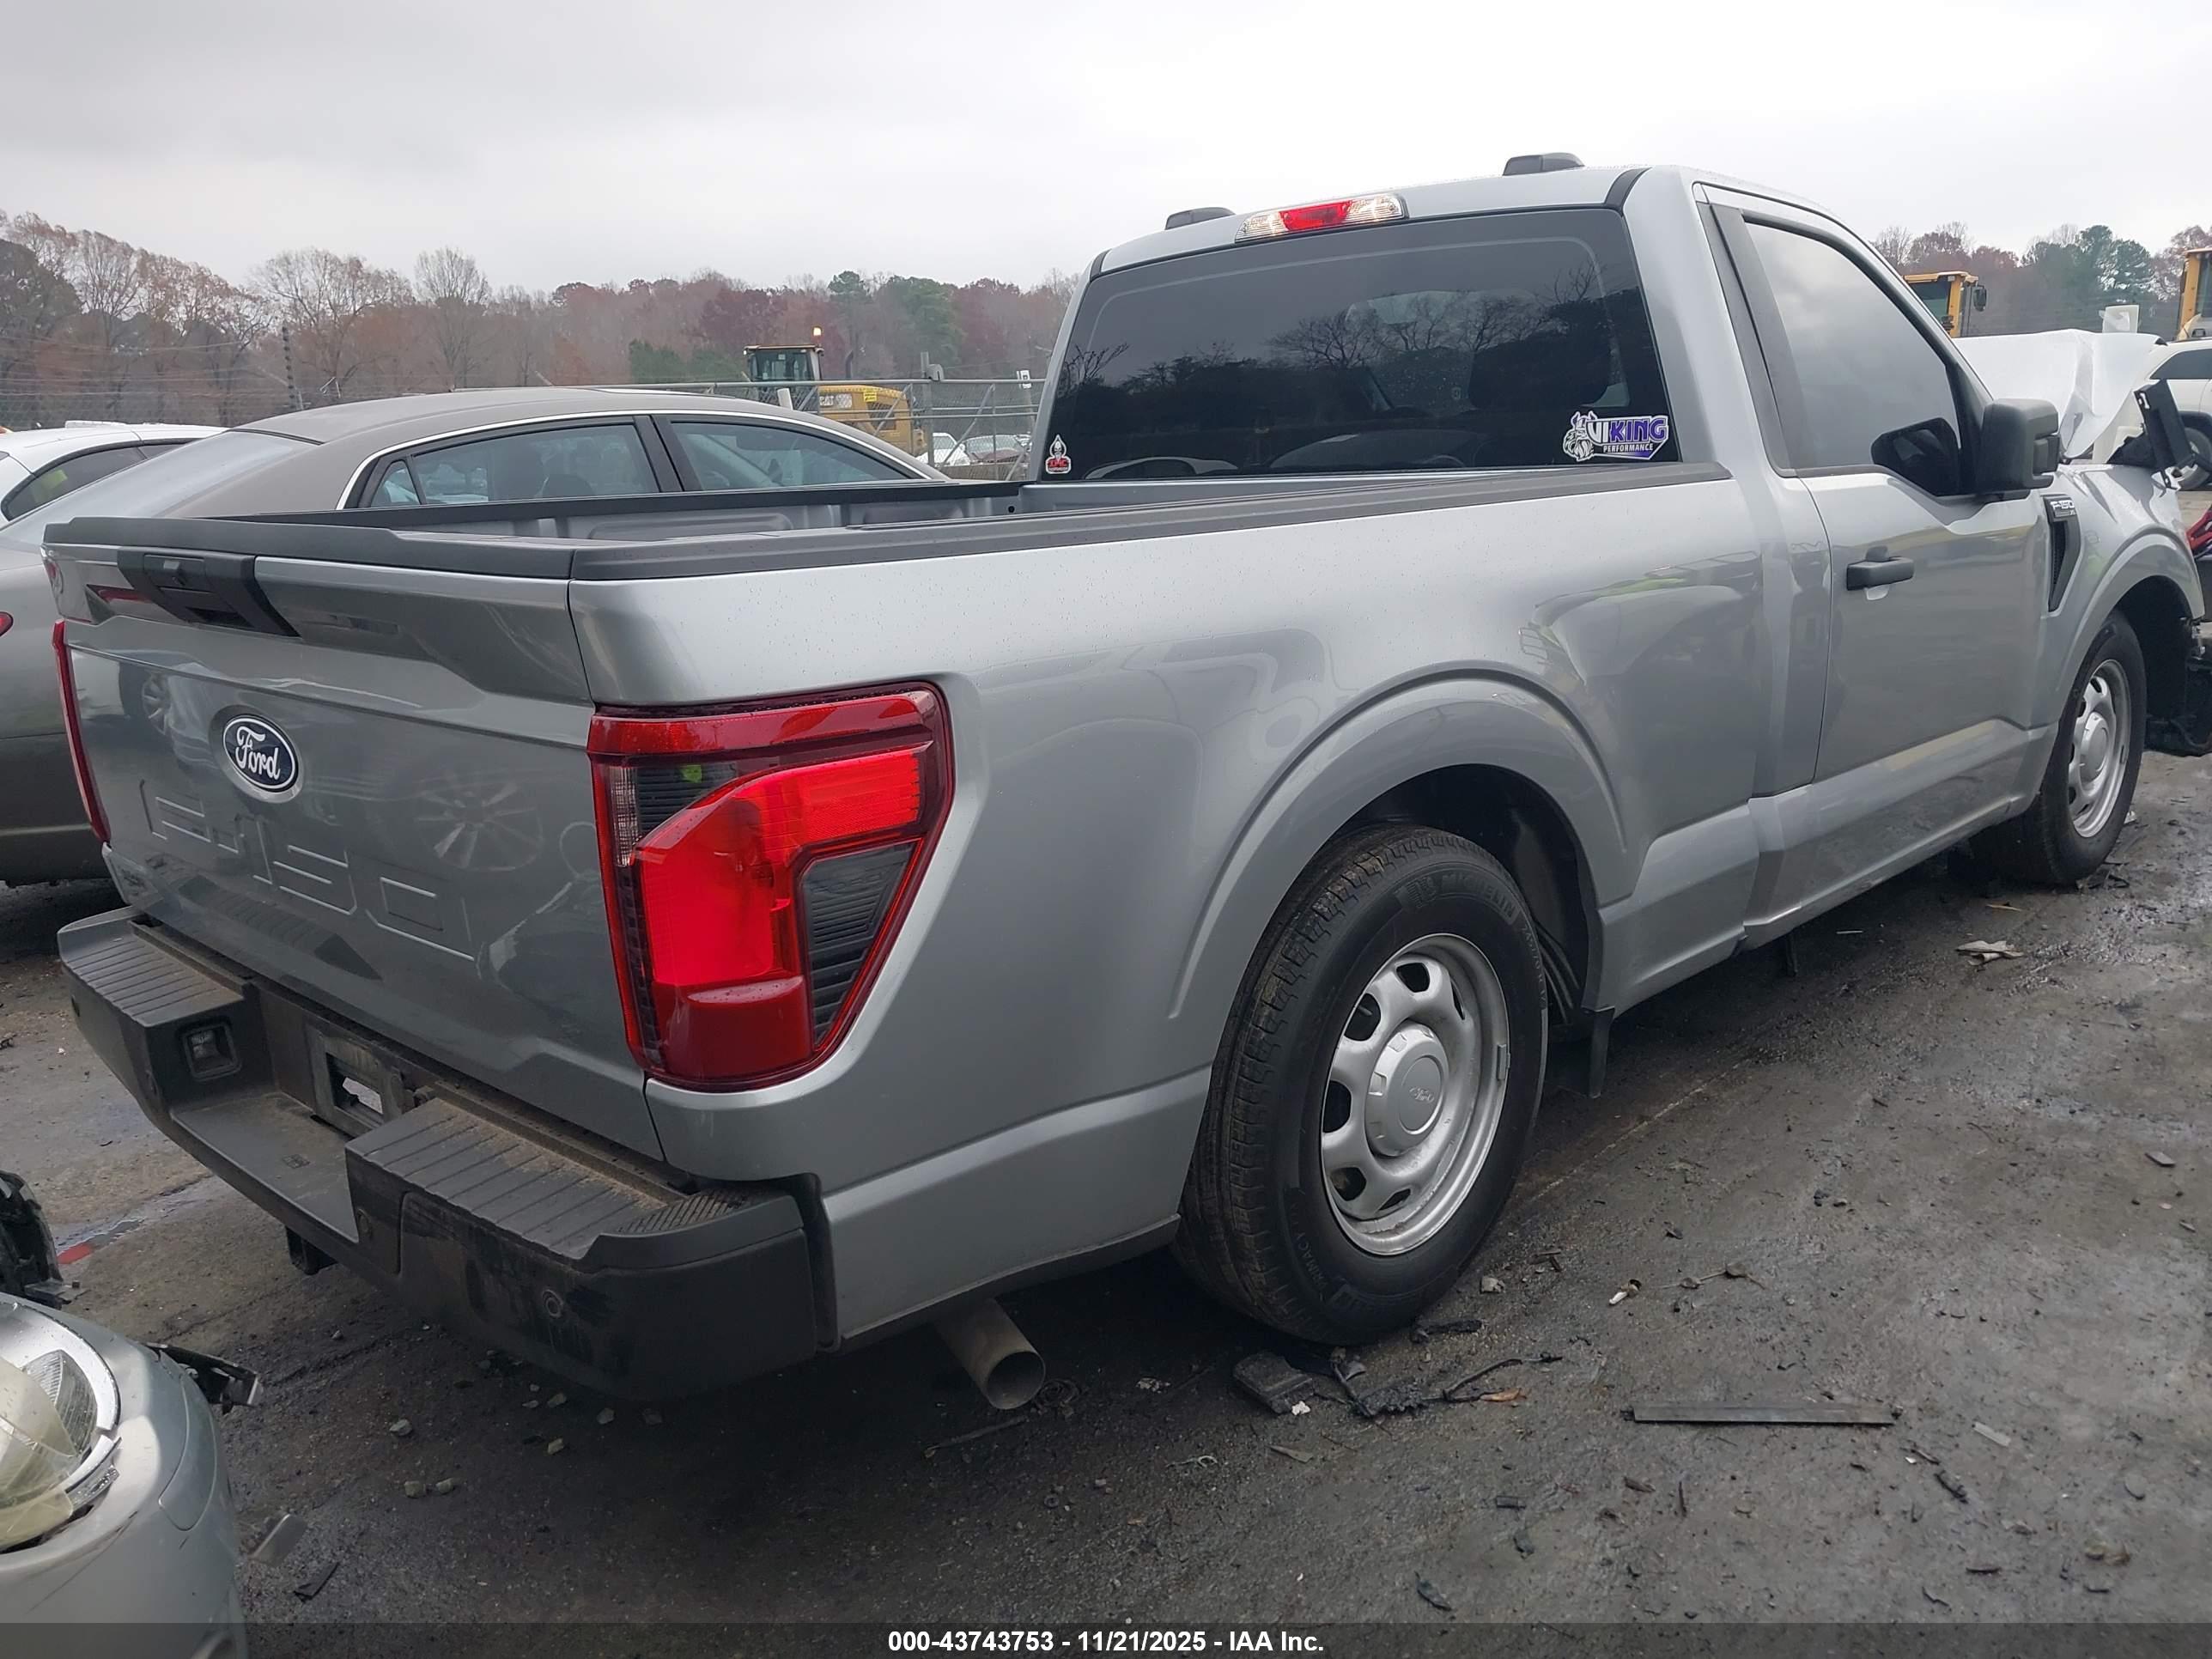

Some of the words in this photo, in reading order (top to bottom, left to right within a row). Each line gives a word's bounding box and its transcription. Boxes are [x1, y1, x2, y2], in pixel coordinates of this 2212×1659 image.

[1587, 417, 1667, 443] VIKING
[1603, 442, 1654, 453] PERFORMANCE
[235, 726, 282, 781] Ford
[1441, 873, 1518, 922] MICHELIN
